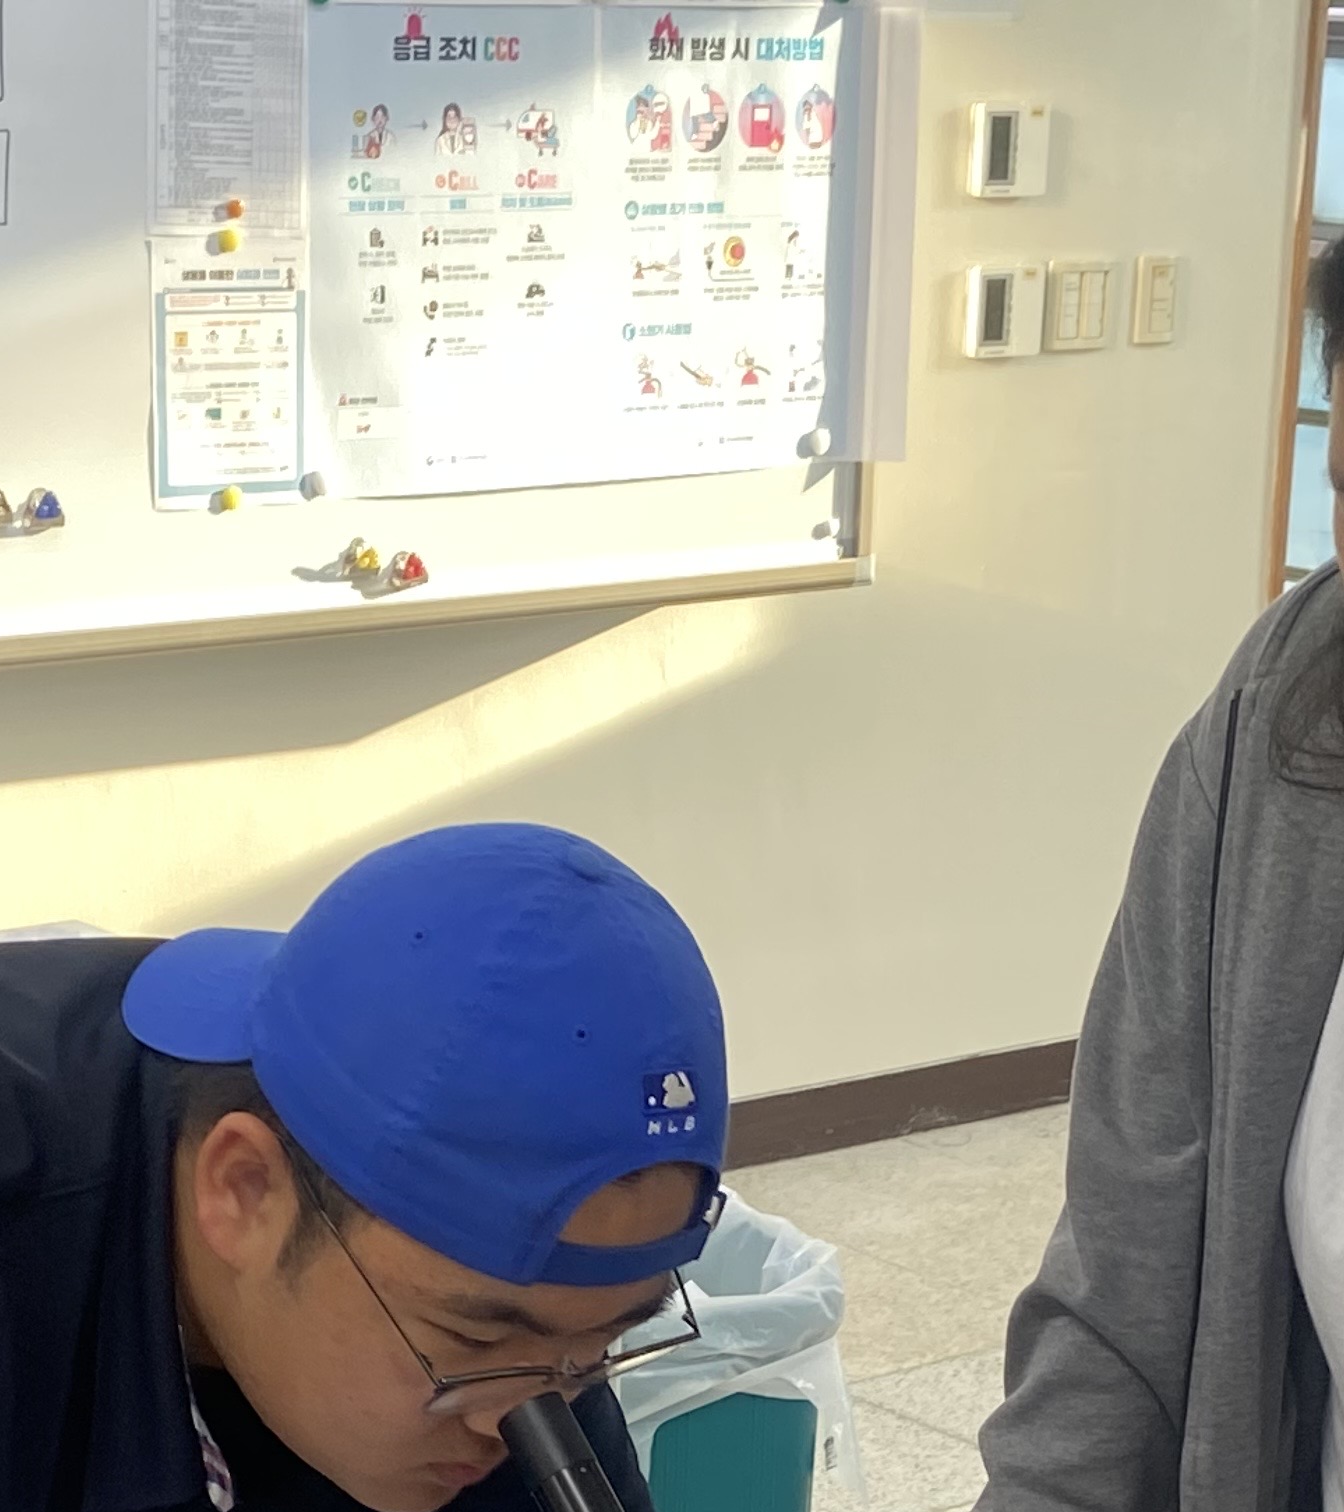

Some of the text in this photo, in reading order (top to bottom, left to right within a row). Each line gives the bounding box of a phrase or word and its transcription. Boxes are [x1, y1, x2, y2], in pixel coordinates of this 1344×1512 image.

[393, 36, 521, 62] 응급 조치 CCC
[649, 36, 825, 61] 화재 발생 시 대처방법
